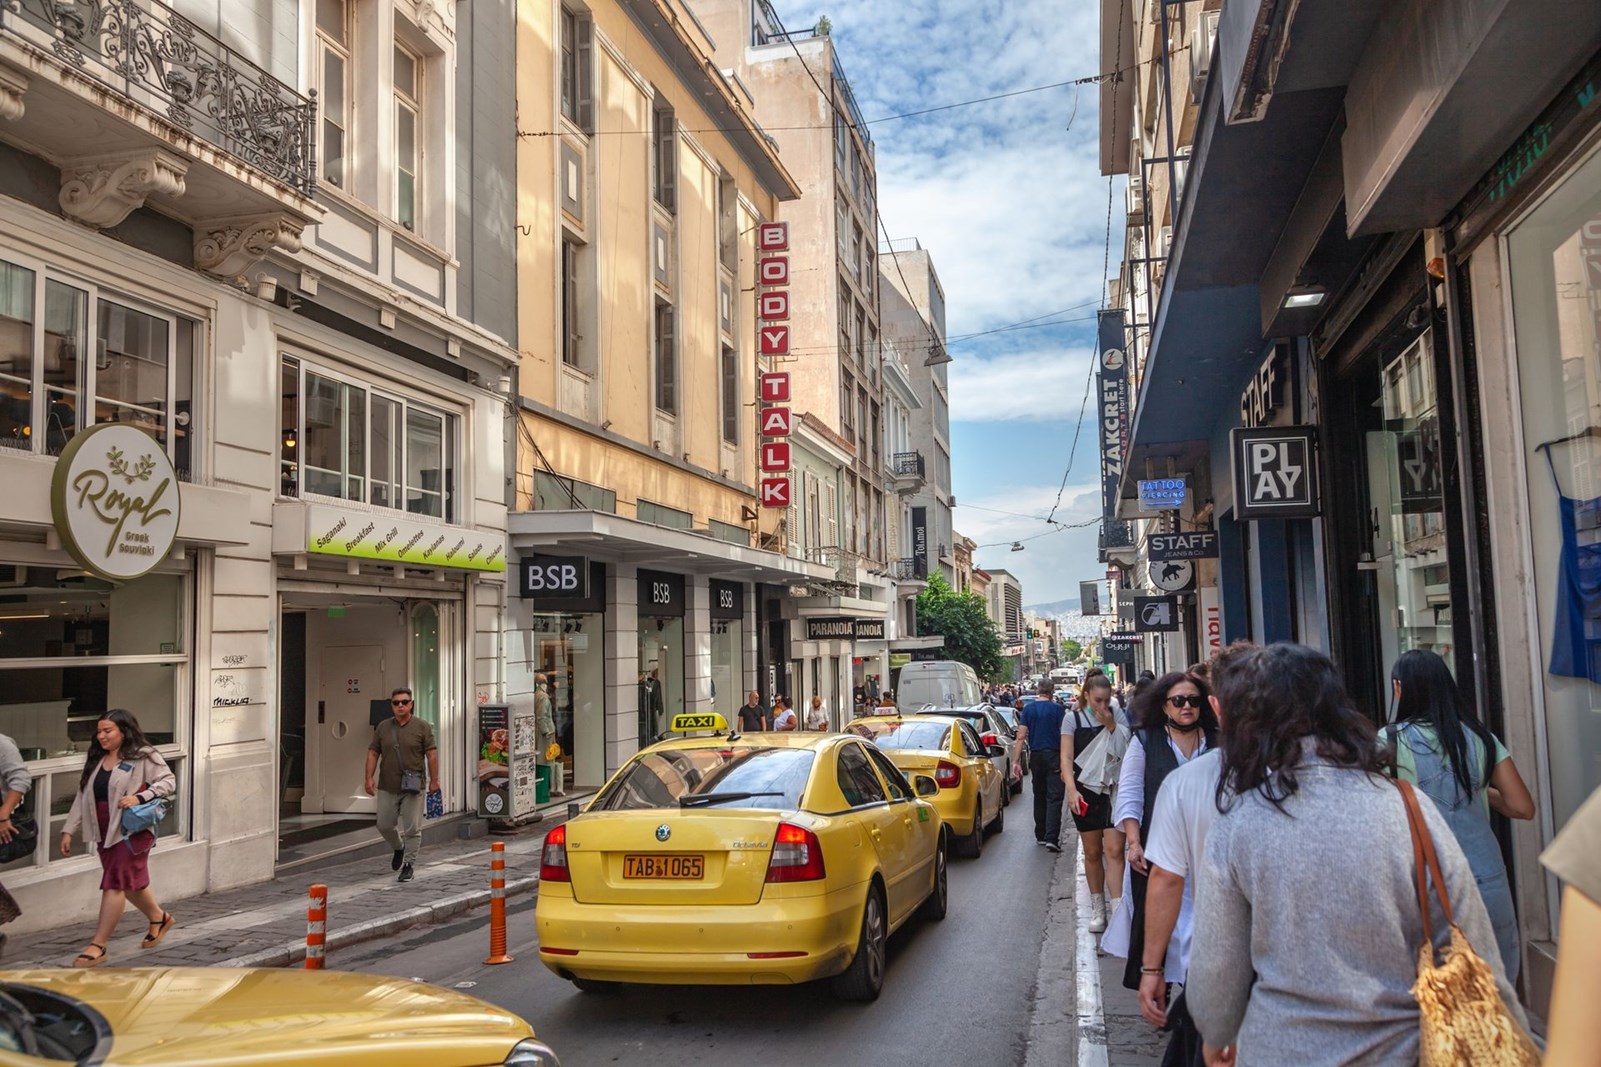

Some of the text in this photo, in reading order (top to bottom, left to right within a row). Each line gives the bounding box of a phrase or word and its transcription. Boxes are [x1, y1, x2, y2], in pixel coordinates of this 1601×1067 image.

[763, 228, 787, 349] BODY
[1241, 345, 1277, 427] STAFF
[1103, 379, 1121, 476] ZAKCRET
[763, 378, 788, 501] TALK
[1141, 491, 1185, 499] PIERCING
[1142, 480, 1185, 490] TATTOO
[73, 469, 172, 558] Royal
[125, 531, 149, 542] Greek
[317, 517, 347, 549] Saganaki
[345, 522, 375, 552] Breakfast
[374, 526, 398, 554] Mix Grill
[397, 530, 424, 558] Omelettes
[1152, 534, 1214, 550] STAFF
[119, 543, 155, 556] Souvlaki
[1164, 550, 1187, 558] JEANS
[528, 565, 578, 590] BSB
[653, 582, 670, 604] BSB
[720, 590, 733, 608] BSB
[678, 716, 713, 727] TAXI
[626, 858, 702, 876] TAB 1065
